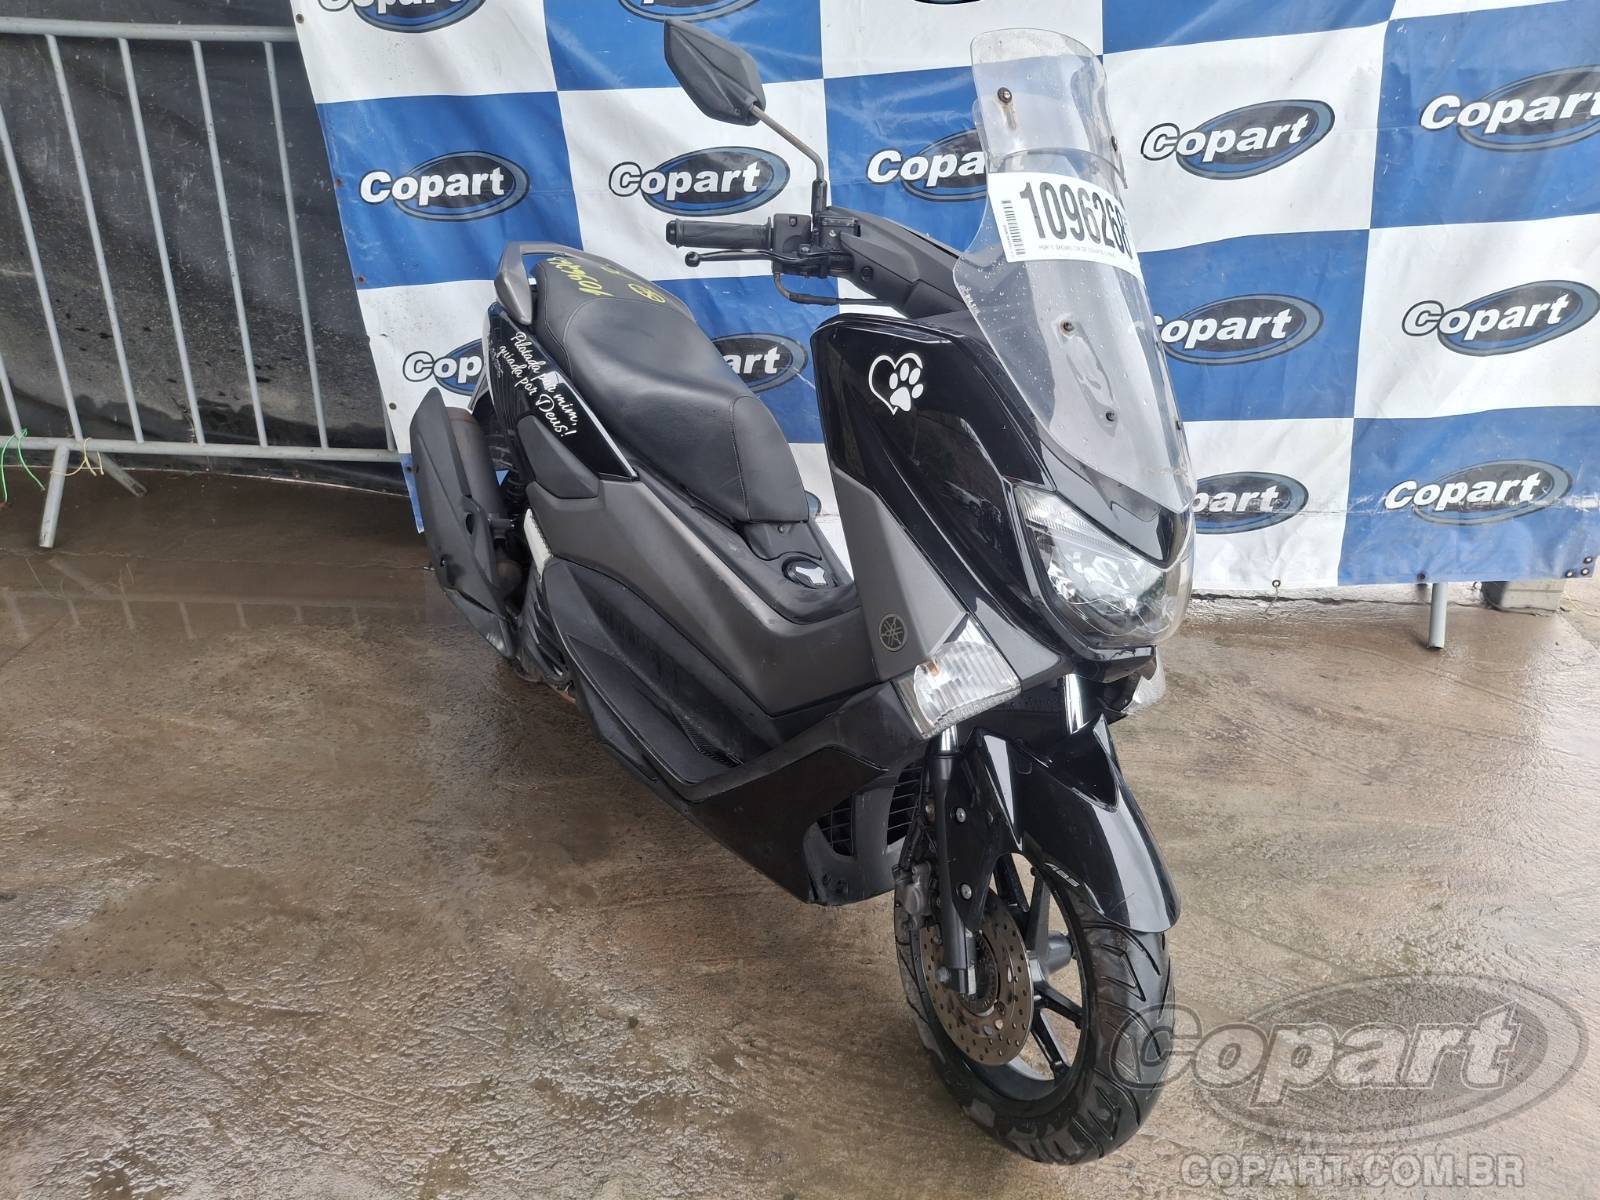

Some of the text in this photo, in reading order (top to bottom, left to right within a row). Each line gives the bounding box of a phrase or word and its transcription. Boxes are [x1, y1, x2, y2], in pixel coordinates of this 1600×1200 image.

[1141, 112, 1309, 163] Copart
[359, 166, 506, 206] Copart
[609, 160, 761, 201] Copart
[866, 149, 987, 188] Copa
[1401, 292, 1570, 342] Copart
[403, 351, 484, 384] Cop
[510, 331, 546, 374] Pilotada
[723, 346, 780, 374] art
[514, 376, 538, 397] por
[535, 393, 577, 437] Deus!
[1383, 471, 1541, 514] Copart
